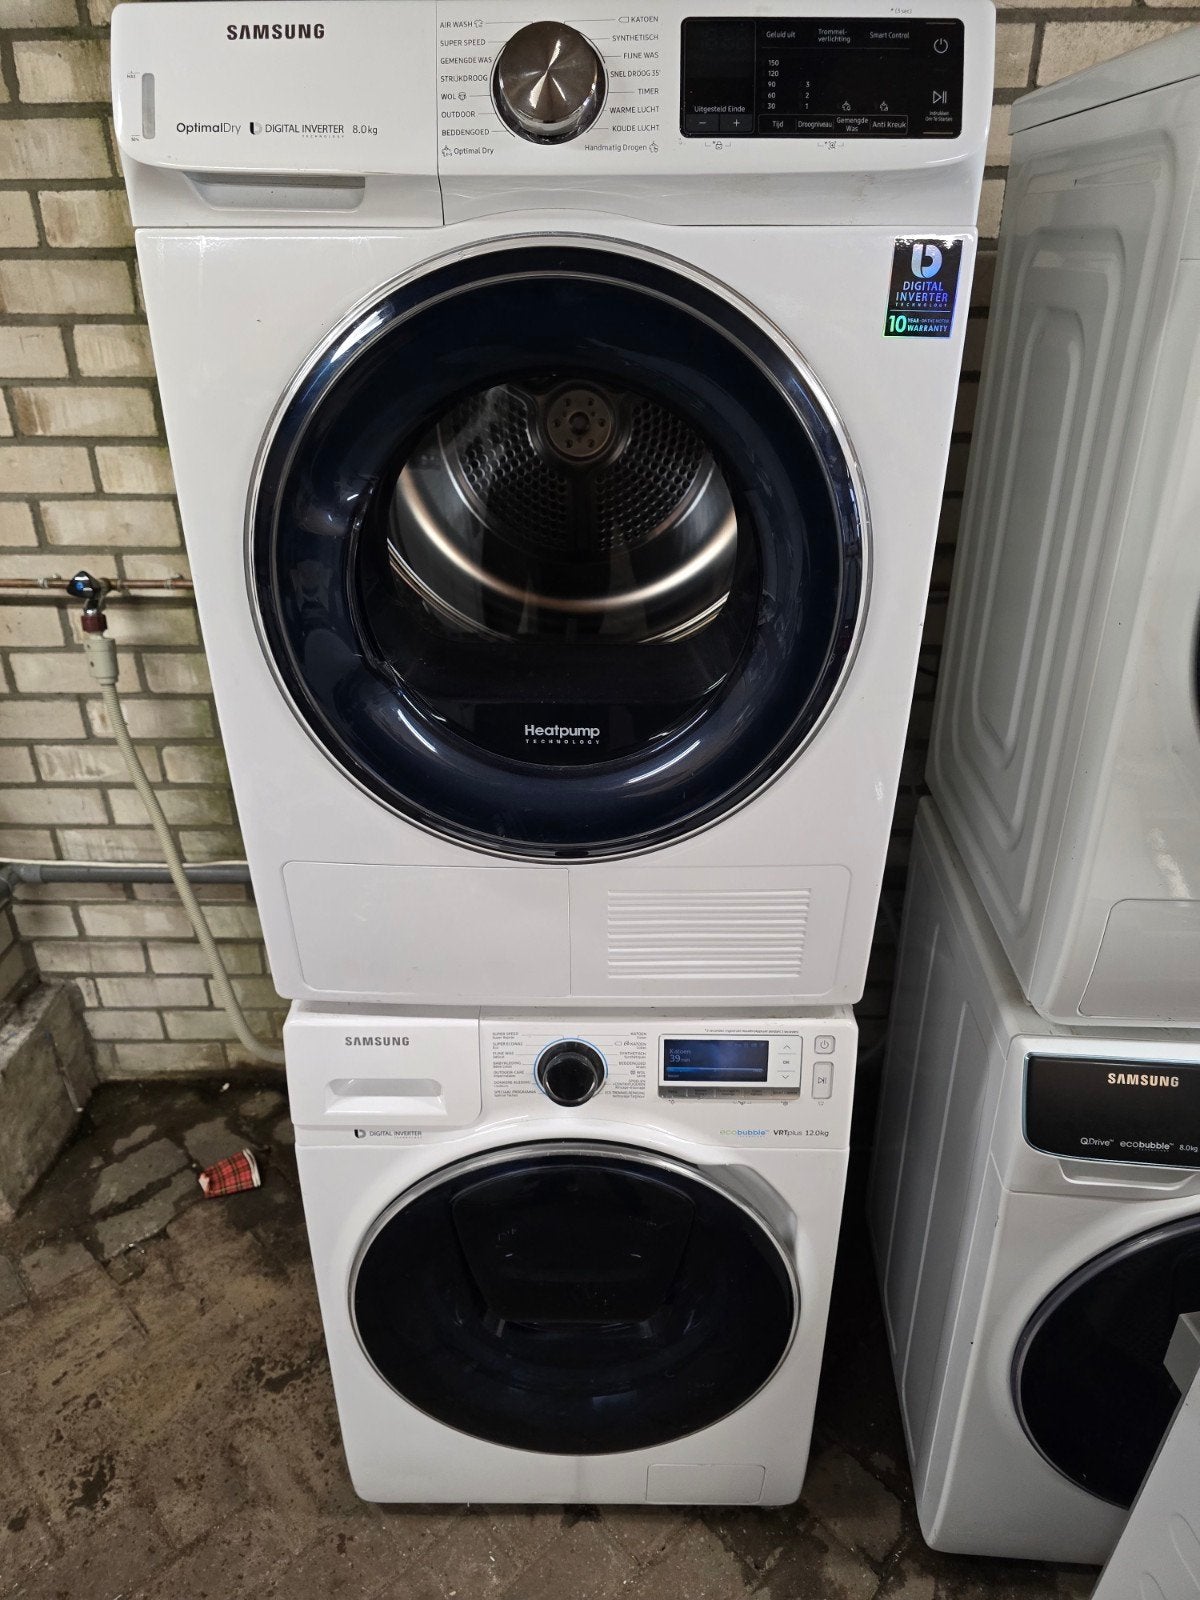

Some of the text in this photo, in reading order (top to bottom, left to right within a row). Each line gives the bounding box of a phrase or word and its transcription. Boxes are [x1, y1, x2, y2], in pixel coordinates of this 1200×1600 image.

[226, 23, 325, 40] SAMSUNG
[766, 31, 796, 39] Geluid uit
[818, 28, 848, 36] Trommel-
[888, 31, 910, 39] Control
[818, 35, 851, 44] verlichting
[440, 57, 477, 65] GEMENGDE
[629, 70, 651, 78] DROOG
[609, 106, 636, 114] WARME
[694, 105, 746, 114] Uitgesteld Einde
[772, 121, 784, 129] Tijd
[836, 117, 869, 125] Gemengde
[887, 121, 907, 129] Kreuk
[176, 122, 378, 136] OptimalDry DIGITAL INVERTER 8.0kg
[612, 124, 636, 132] KOUDE
[798, 121, 833, 130] Droogniveau
[441, 128, 490, 136] BEDDENGOED
[453, 147, 494, 156] Optimal Dry
[584, 144, 648, 152] Handmatig Drogen
[903, 281, 944, 291] DIGITAL
[895, 292, 949, 302] INVERTER
[888, 315, 907, 333] 10
[907, 324, 948, 332] WARRANTY
[524, 724, 600, 739] Heatpump
[345, 1037, 410, 1047] SAMSUNG
[1107, 1072, 1179, 1088] SAMSUNG
[773, 1129, 803, 1137] VRTplus
[1179, 1144, 1199, 1153] 8.0kg
